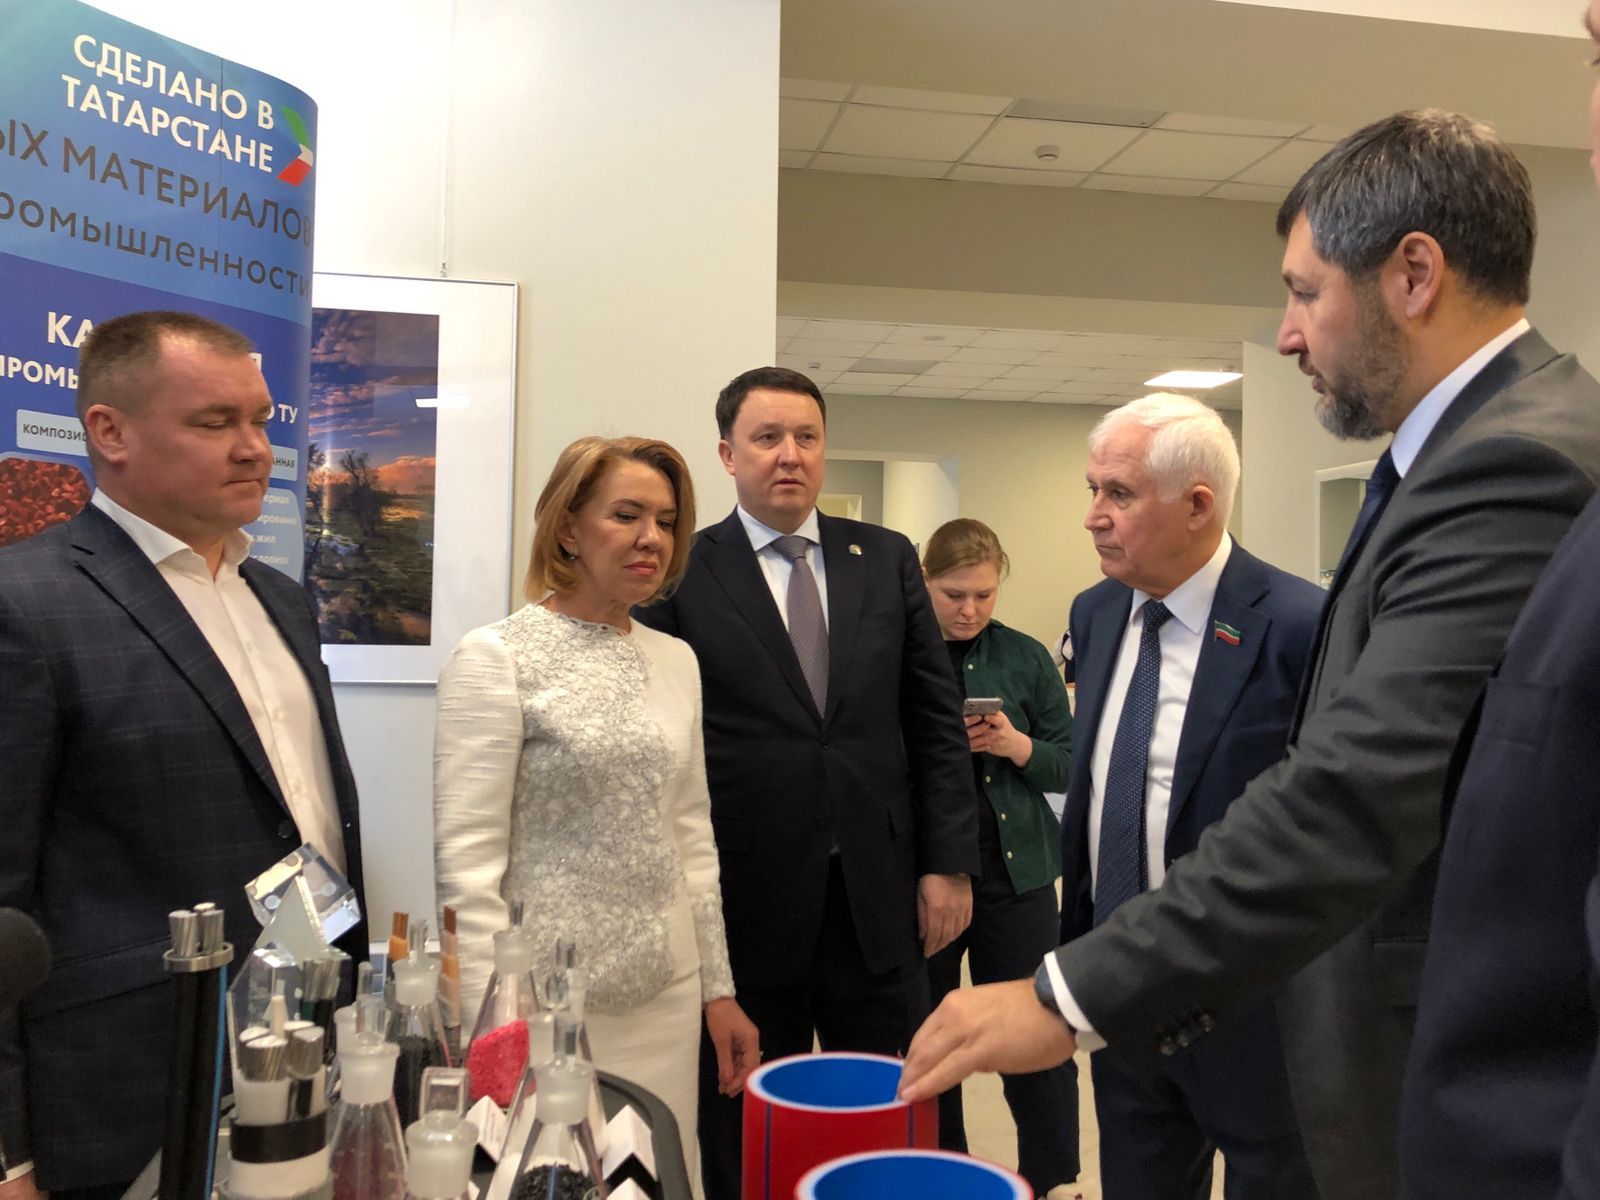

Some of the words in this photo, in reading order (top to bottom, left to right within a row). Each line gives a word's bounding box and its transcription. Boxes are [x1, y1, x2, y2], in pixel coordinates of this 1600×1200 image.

[61, 74, 273, 173] ТАТАРСТАНЕ
[73, 34, 248, 119] СДЕЛАНО
[257, 99, 274, 130] В
[63, 136, 311, 247] МАТЕРИАЛОВ
[278, 403, 298, 424] ТУ
